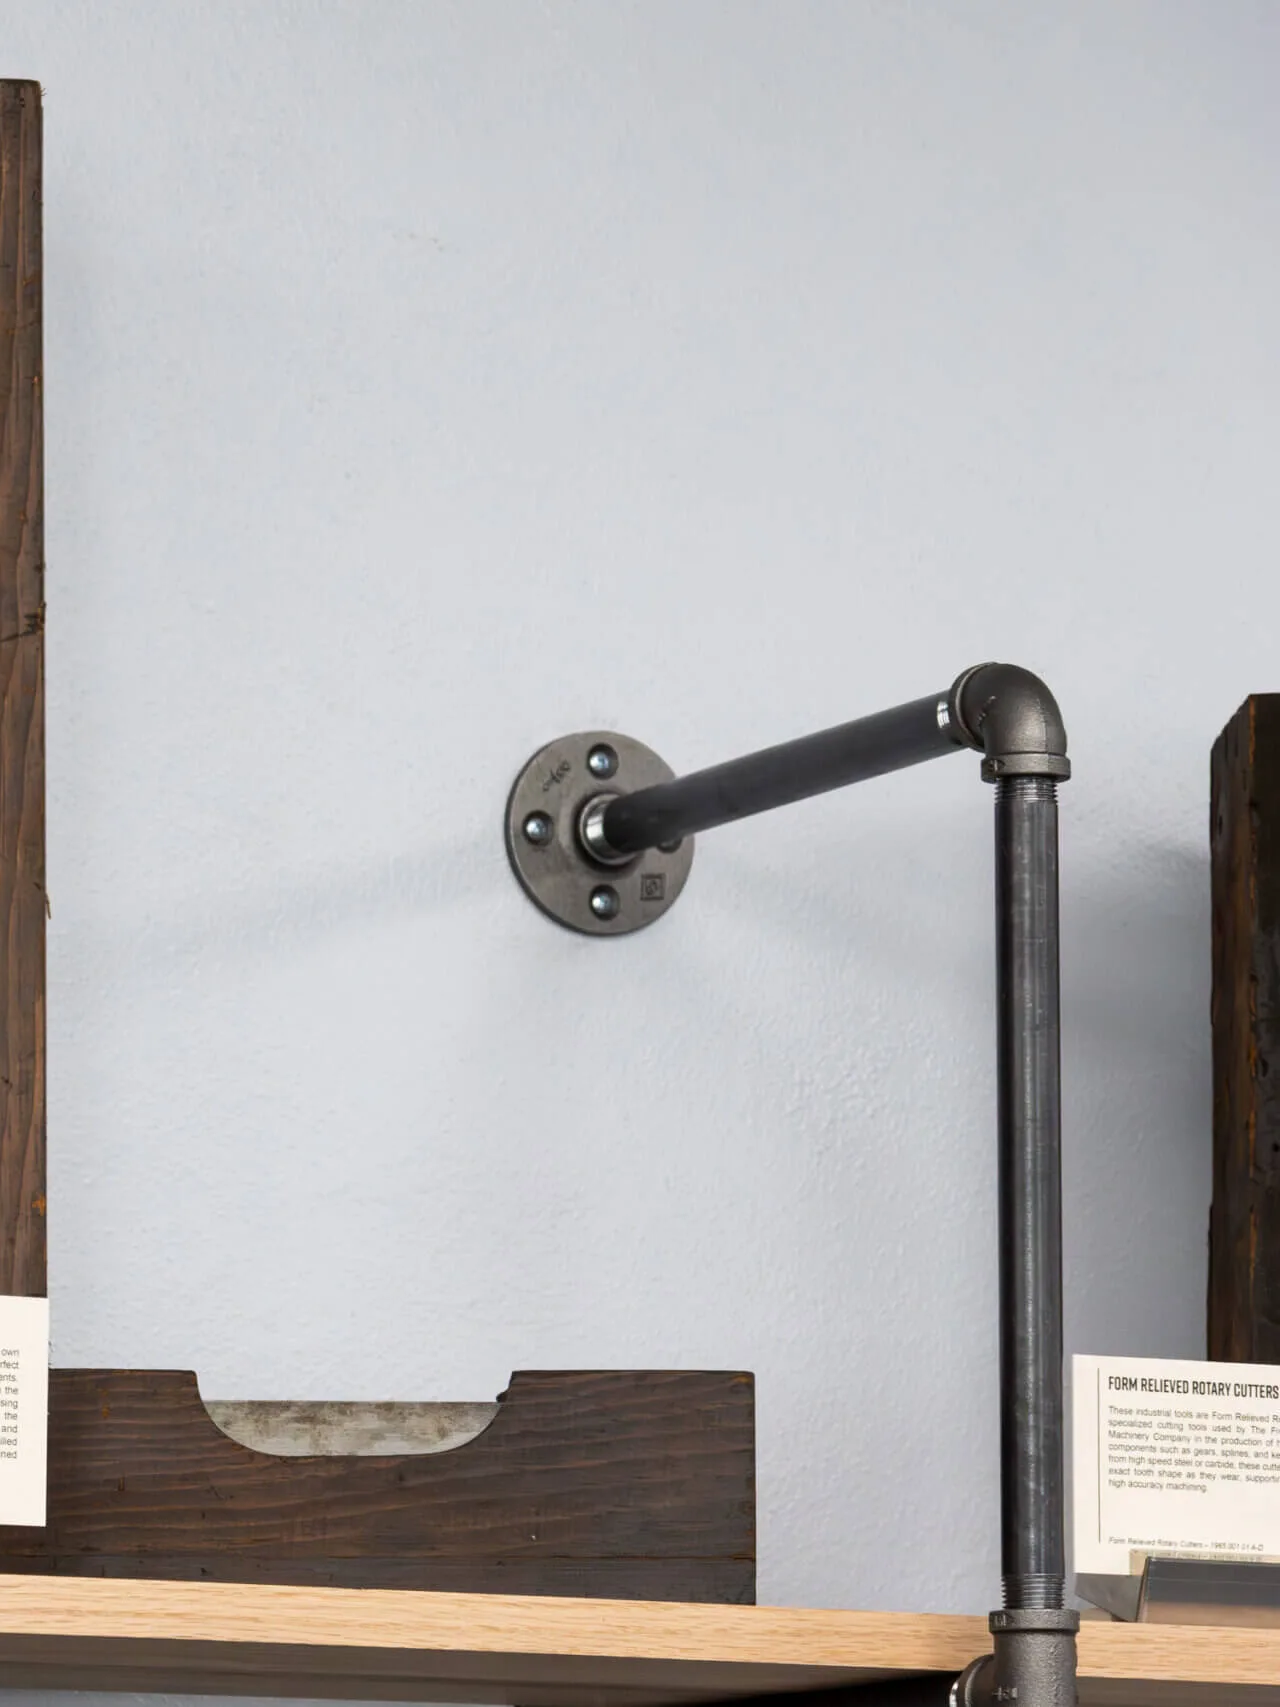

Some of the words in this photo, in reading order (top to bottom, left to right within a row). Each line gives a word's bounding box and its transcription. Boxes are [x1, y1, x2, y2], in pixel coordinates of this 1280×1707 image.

[1, 1349, 19, 1357] own
[5, 1385, 18, 1395] the
[1109, 1376, 1137, 1391] FORM
[1141, 1378, 1188, 1394] RELIEVED
[1193, 1381, 1230, 1397] ROTARY
[1234, 1383, 1279, 1399] CUTTERS
[4, 1411, 18, 1420] the
[1109, 1405, 1133, 1415] These
[1136, 1407, 1172, 1417] industrial
[1174, 1409, 1193, 1418] tools
[1212, 1411, 1232, 1420] Form
[1235, 1412, 1269, 1422] Relieved
[2, 1424, 18, 1433] and
[1108, 1418, 1152, 1430] specialized
[1157, 1421, 1184, 1432] cutting
[1188, 1422, 1207, 1432] tools
[1212, 1424, 1231, 1433] used
[1236, 1425, 1245, 1435] by
[1250, 1426, 1266, 1435] The
[1108, 1430, 1149, 1442] Machinery
[1153, 1432, 1192, 1444] Company
[1194, 1435, 1202, 1444] in
[1205, 1435, 1218, 1444] the
[1221, 1436, 1262, 1448] production
[1266, 1438, 1274, 1447] of
[1108, 1442, 1157, 1454] components
[1160, 1445, 1179, 1454] such
[1182, 1447, 1191, 1455] as
[1254, 1450, 1269, 1459] and
[1108, 1454, 1127, 1463] from
[1129, 1455, 1146, 1466] high
[1147, 1456, 1172, 1467] speed
[1174, 1457, 1193, 1467] steel
[1238, 1461, 1260, 1470] these
[1109, 1466, 1130, 1476] exact
[1134, 1467, 1154, 1477] tooth
[1158, 1469, 1183, 1480] shape
[1200, 1471, 1216, 1482] they
[1109, 1478, 1125, 1489] high
[1129, 1481, 1162, 1490] accuracy
